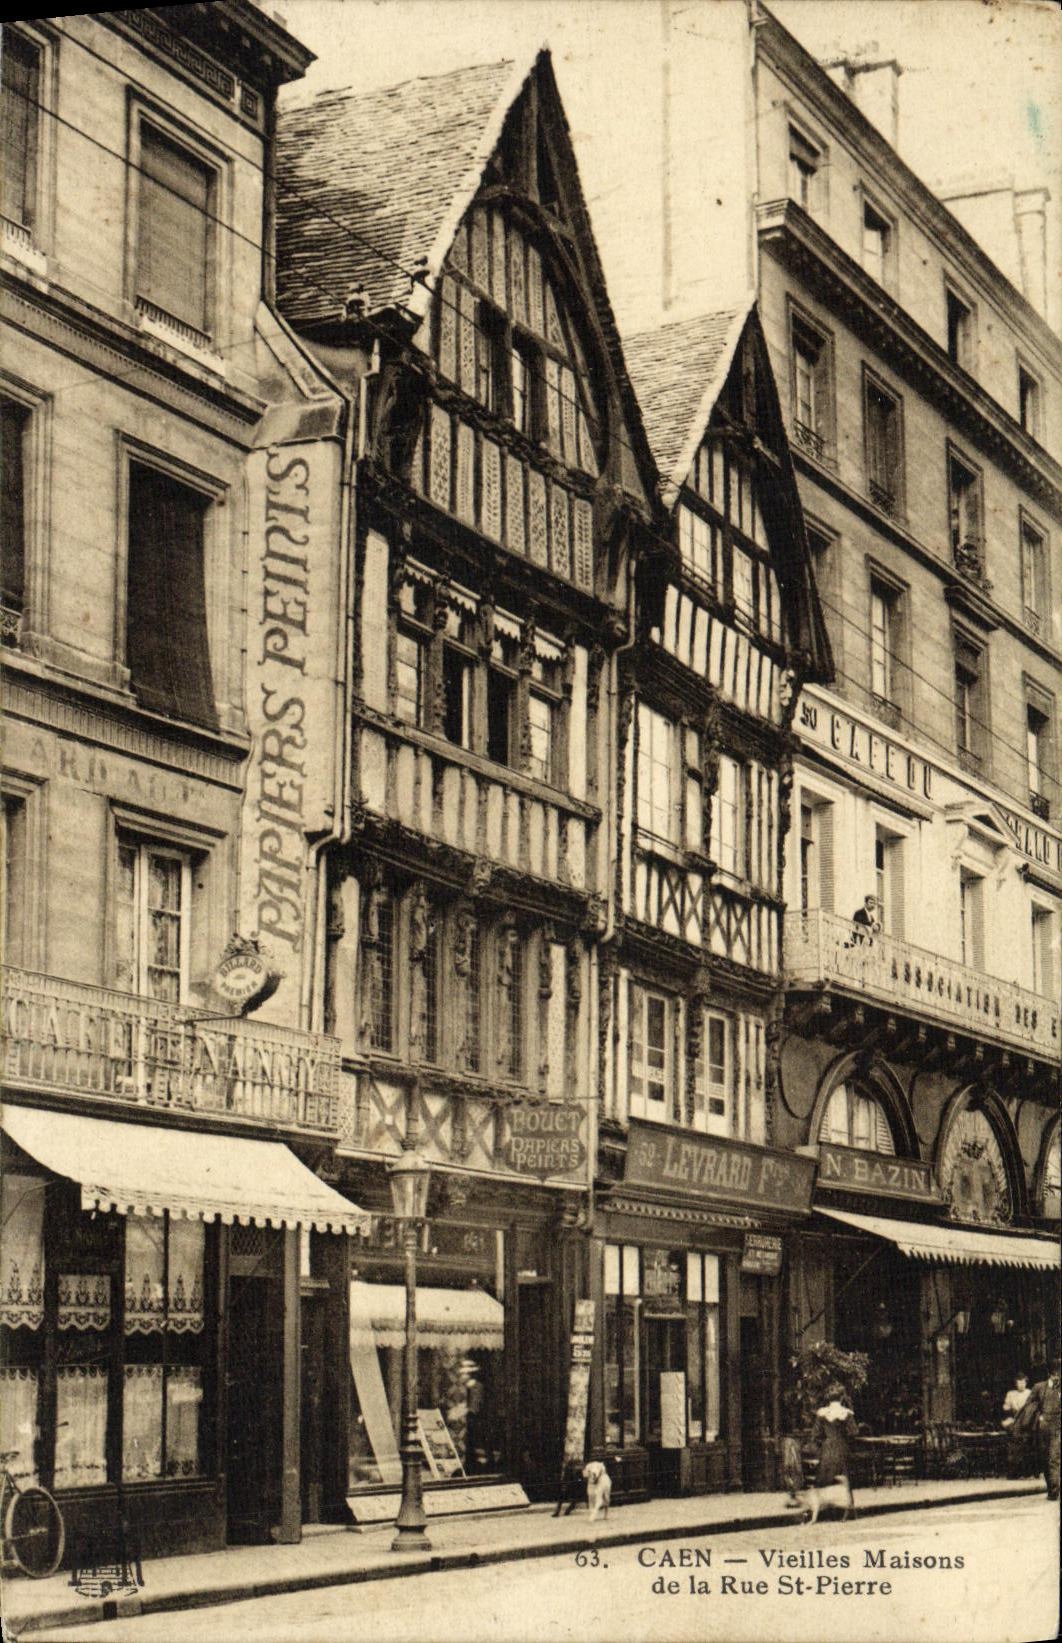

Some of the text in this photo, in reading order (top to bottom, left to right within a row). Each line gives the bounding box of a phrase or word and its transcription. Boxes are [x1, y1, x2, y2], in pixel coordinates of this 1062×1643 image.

[253, 451, 310, 953] PAPIERS PEINTS
[219, 956, 263, 978] BILLARD
[890, 956, 1000, 1018] ASSOCIATION
[511, 1109, 580, 1132] BOUET
[662, 1135, 751, 1190] LEVRARD
[854, 1158, 926, 1190] BAZIN
